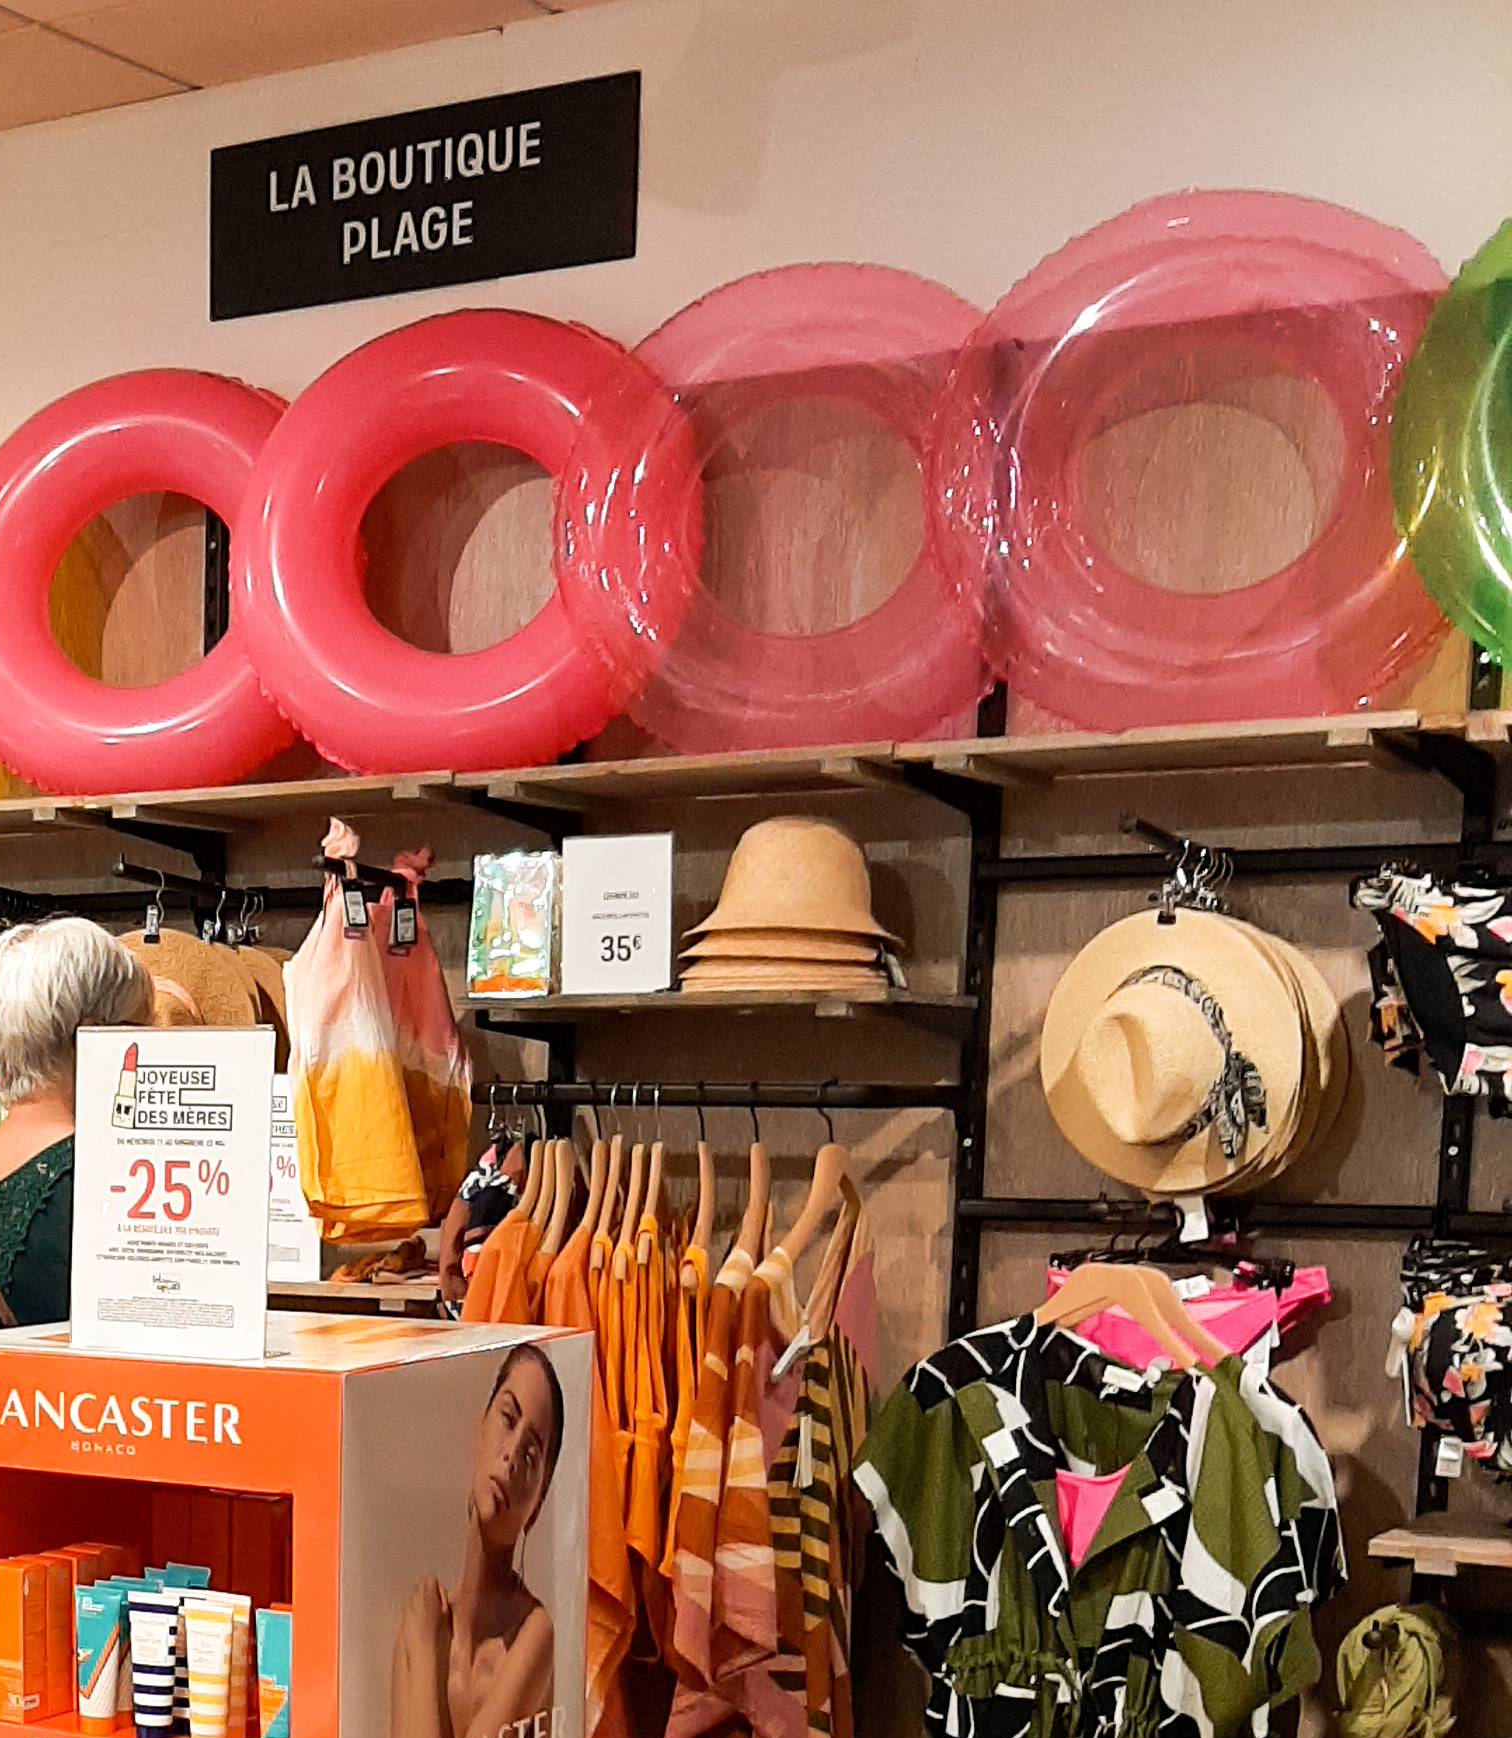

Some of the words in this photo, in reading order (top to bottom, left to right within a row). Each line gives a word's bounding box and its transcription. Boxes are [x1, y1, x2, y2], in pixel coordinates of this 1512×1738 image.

[269, 164, 316, 212] LA
[332, 120, 541, 201] BOUTIQUE
[343, 200, 474, 264] PLAGE
[138, 1070, 210, 1086] JOYEUSE
[138, 1087, 176, 1105] FÊTE
[138, 1109, 169, 1125] DES
[175, 1107, 228, 1126] MÈRES
[110, 1158, 230, 1221] -25%
[70, 1439, 136, 1456] MONACO
